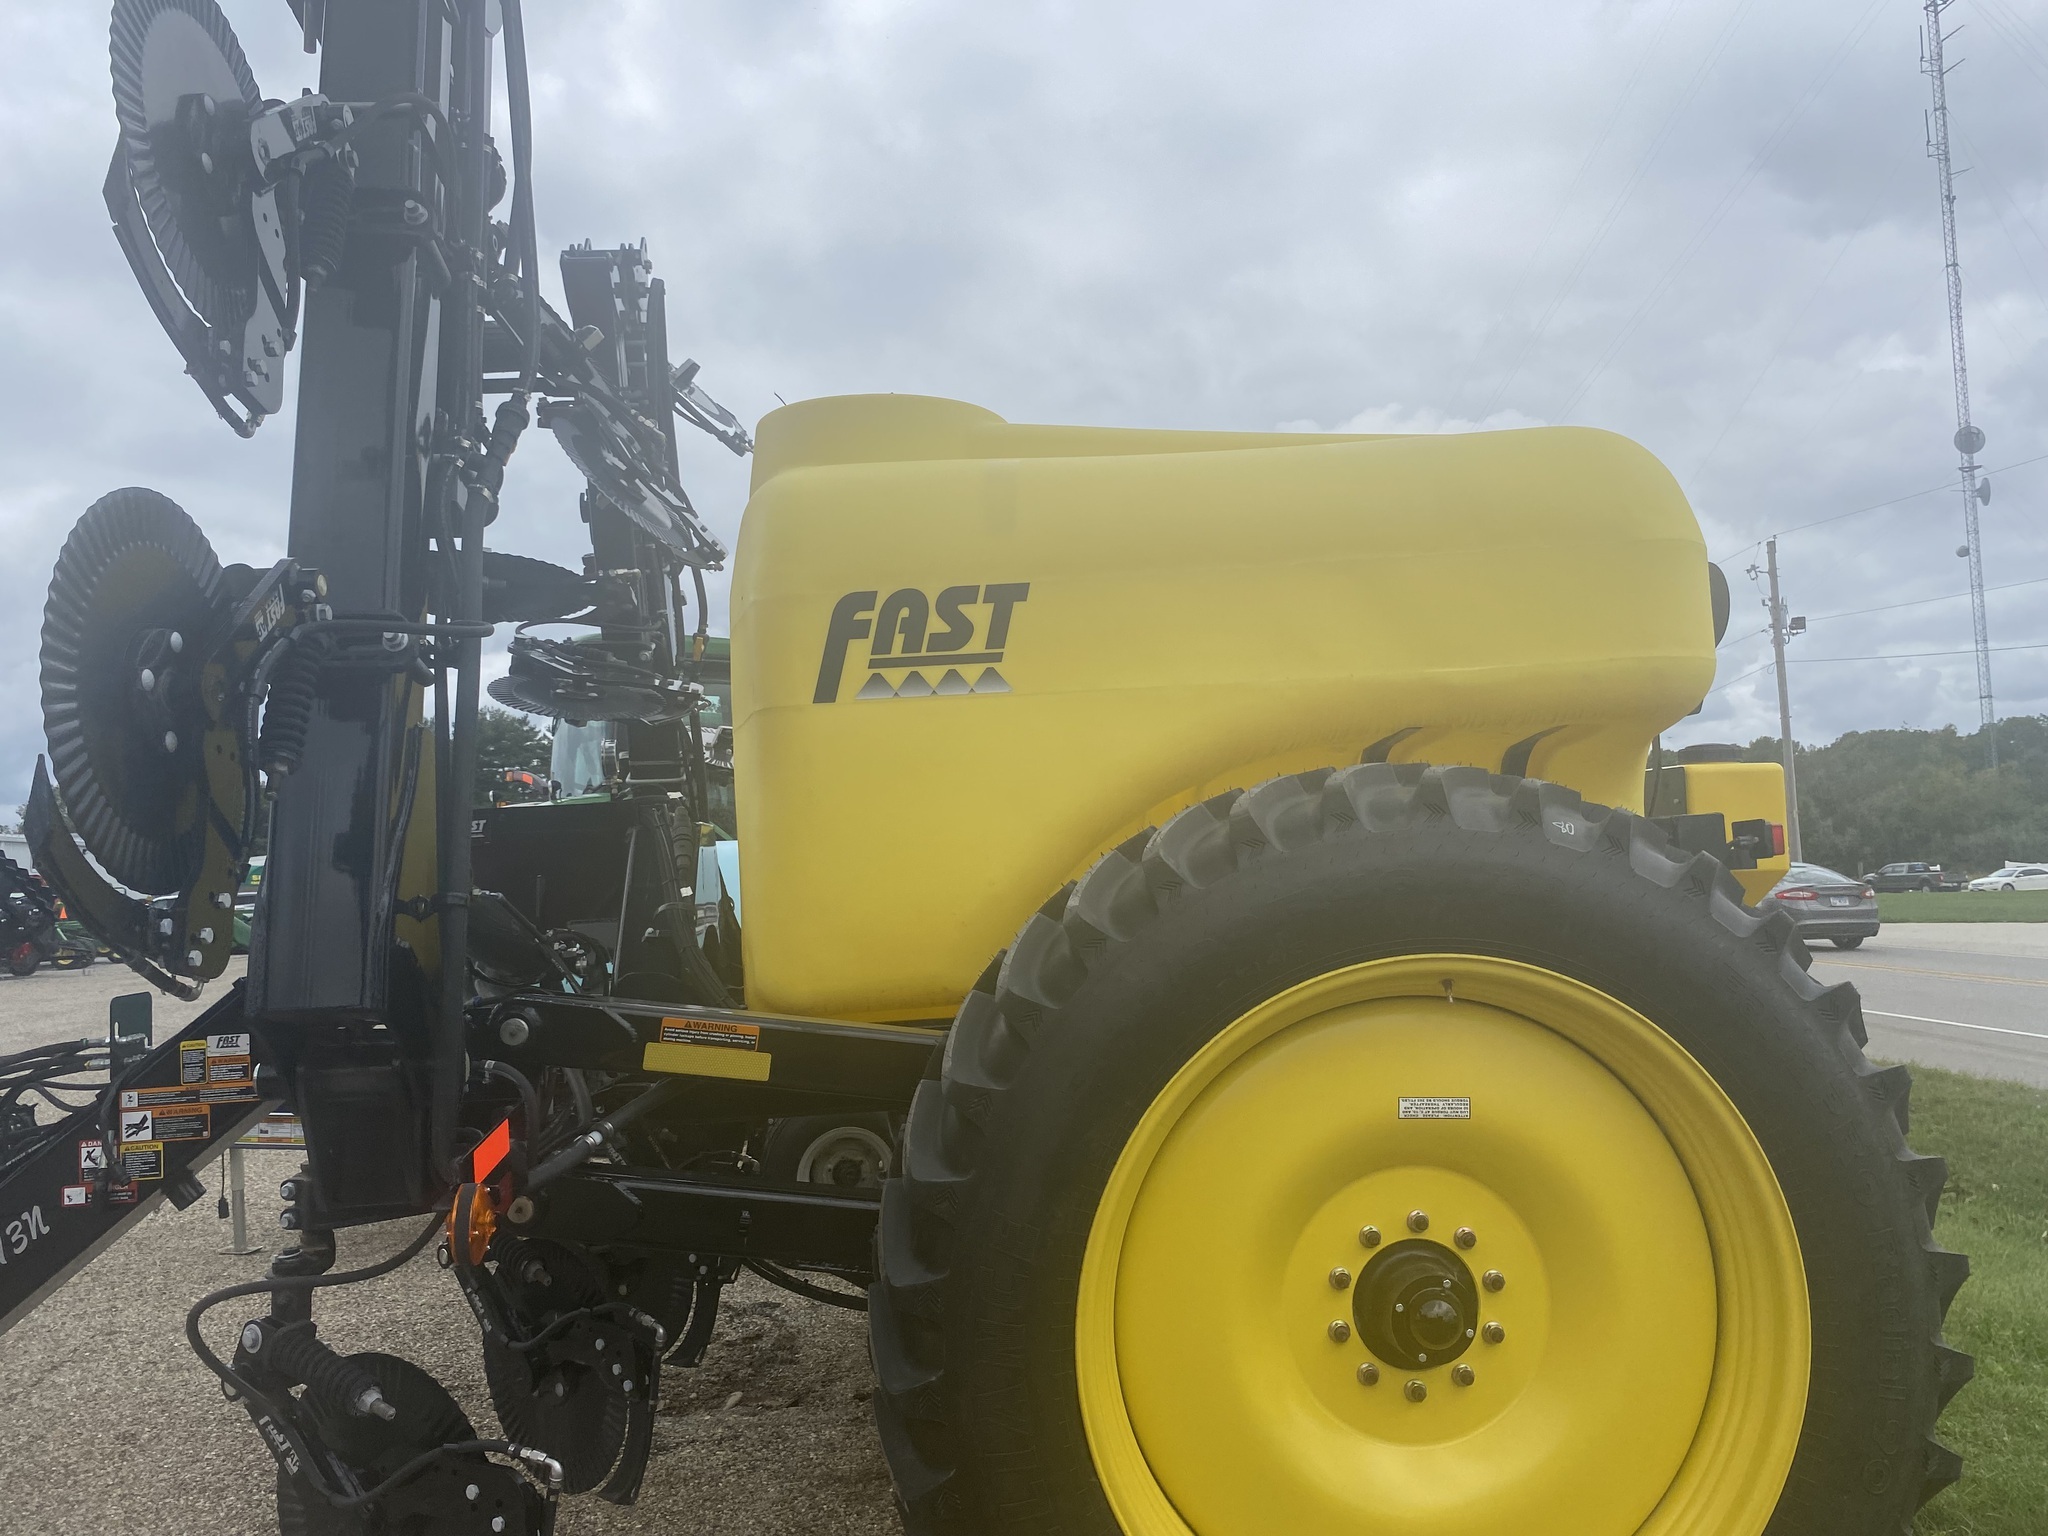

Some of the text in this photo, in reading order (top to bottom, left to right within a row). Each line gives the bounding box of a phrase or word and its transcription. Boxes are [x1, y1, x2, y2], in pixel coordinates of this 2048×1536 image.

[813, 582, 1030, 704] FAST
[471, 820, 487, 831] ST
[693, 1022, 738, 1033] WARNING
[216, 1036, 240, 1048] FAST
[167, 1107, 203, 1115] WARNING
[1867, 1227, 1908, 1400] Radial
